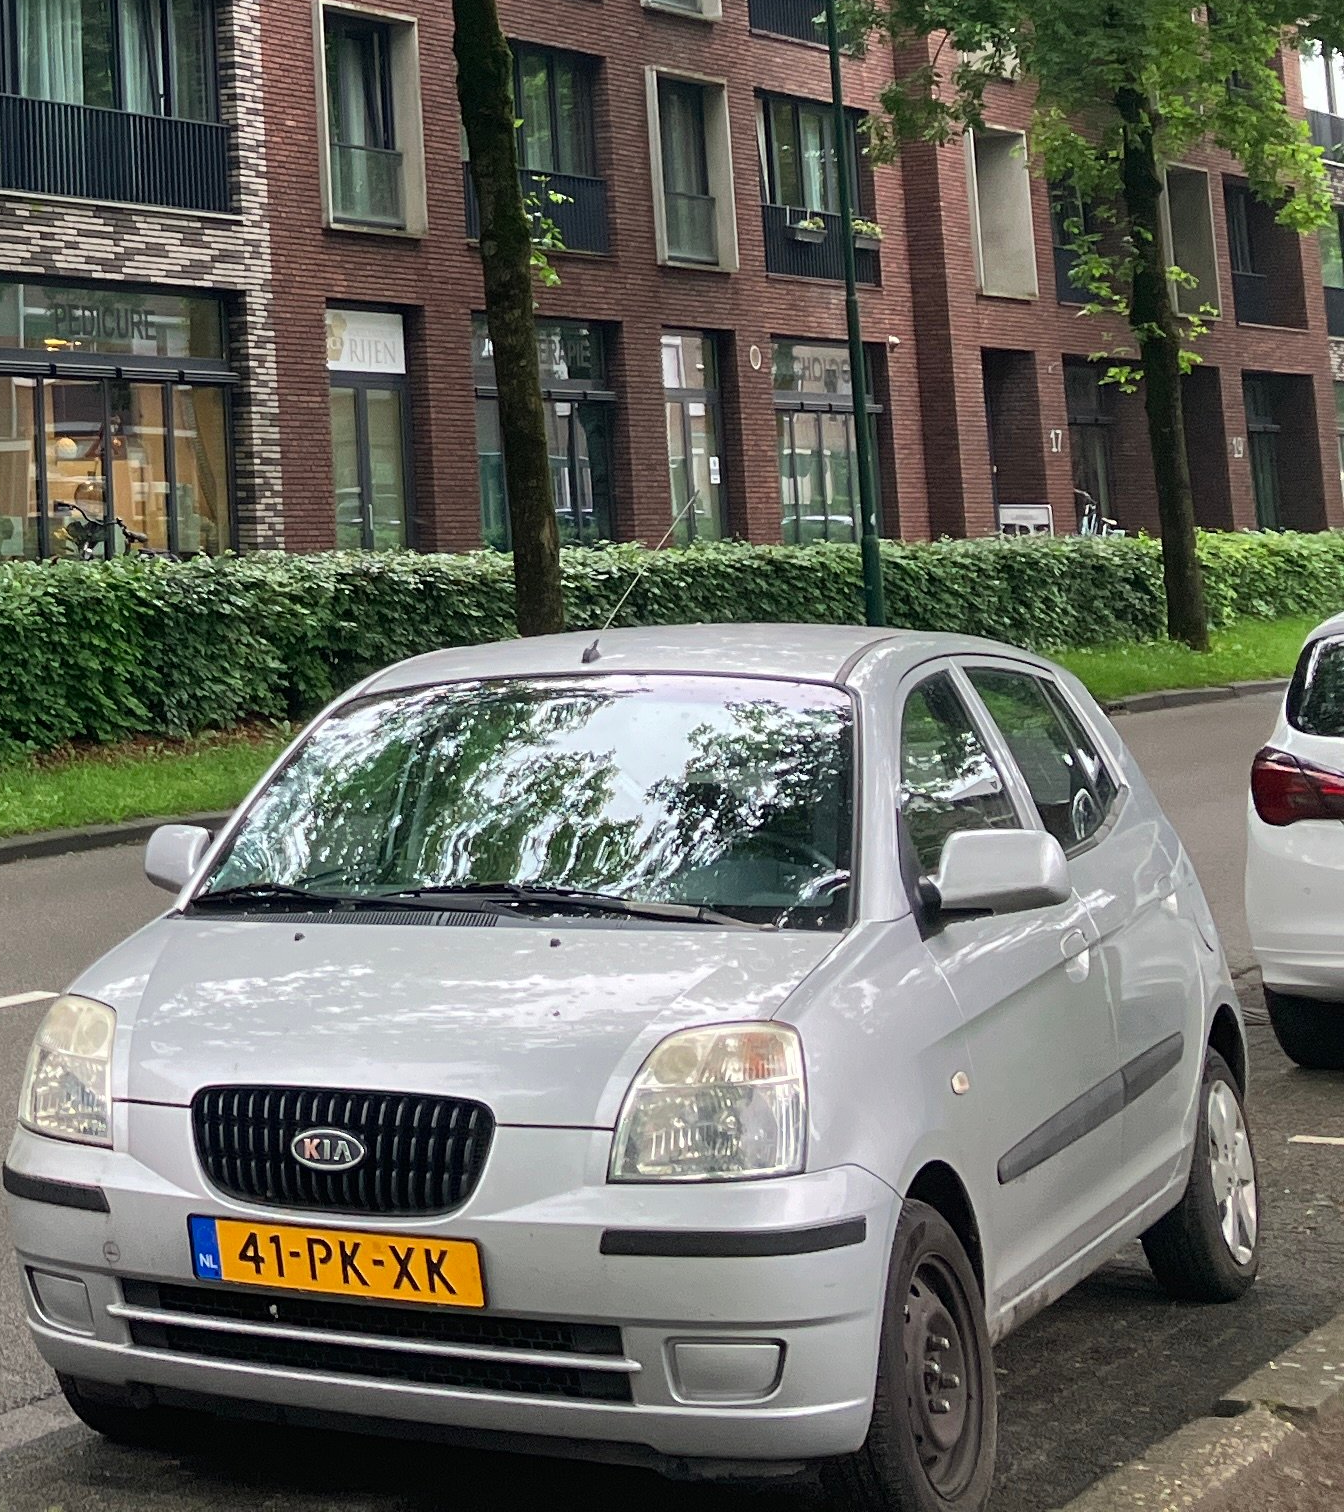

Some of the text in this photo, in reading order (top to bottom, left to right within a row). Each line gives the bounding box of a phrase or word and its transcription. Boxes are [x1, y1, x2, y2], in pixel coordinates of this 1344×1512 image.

[53, 303, 157, 340] PEDICURE
[349, 338, 396, 368] RIJEN
[1050, 429, 1062, 453] 17
[303, 1138, 352, 1163] KIA
[199, 1232, 457, 1296] NL 41-PK-XK
